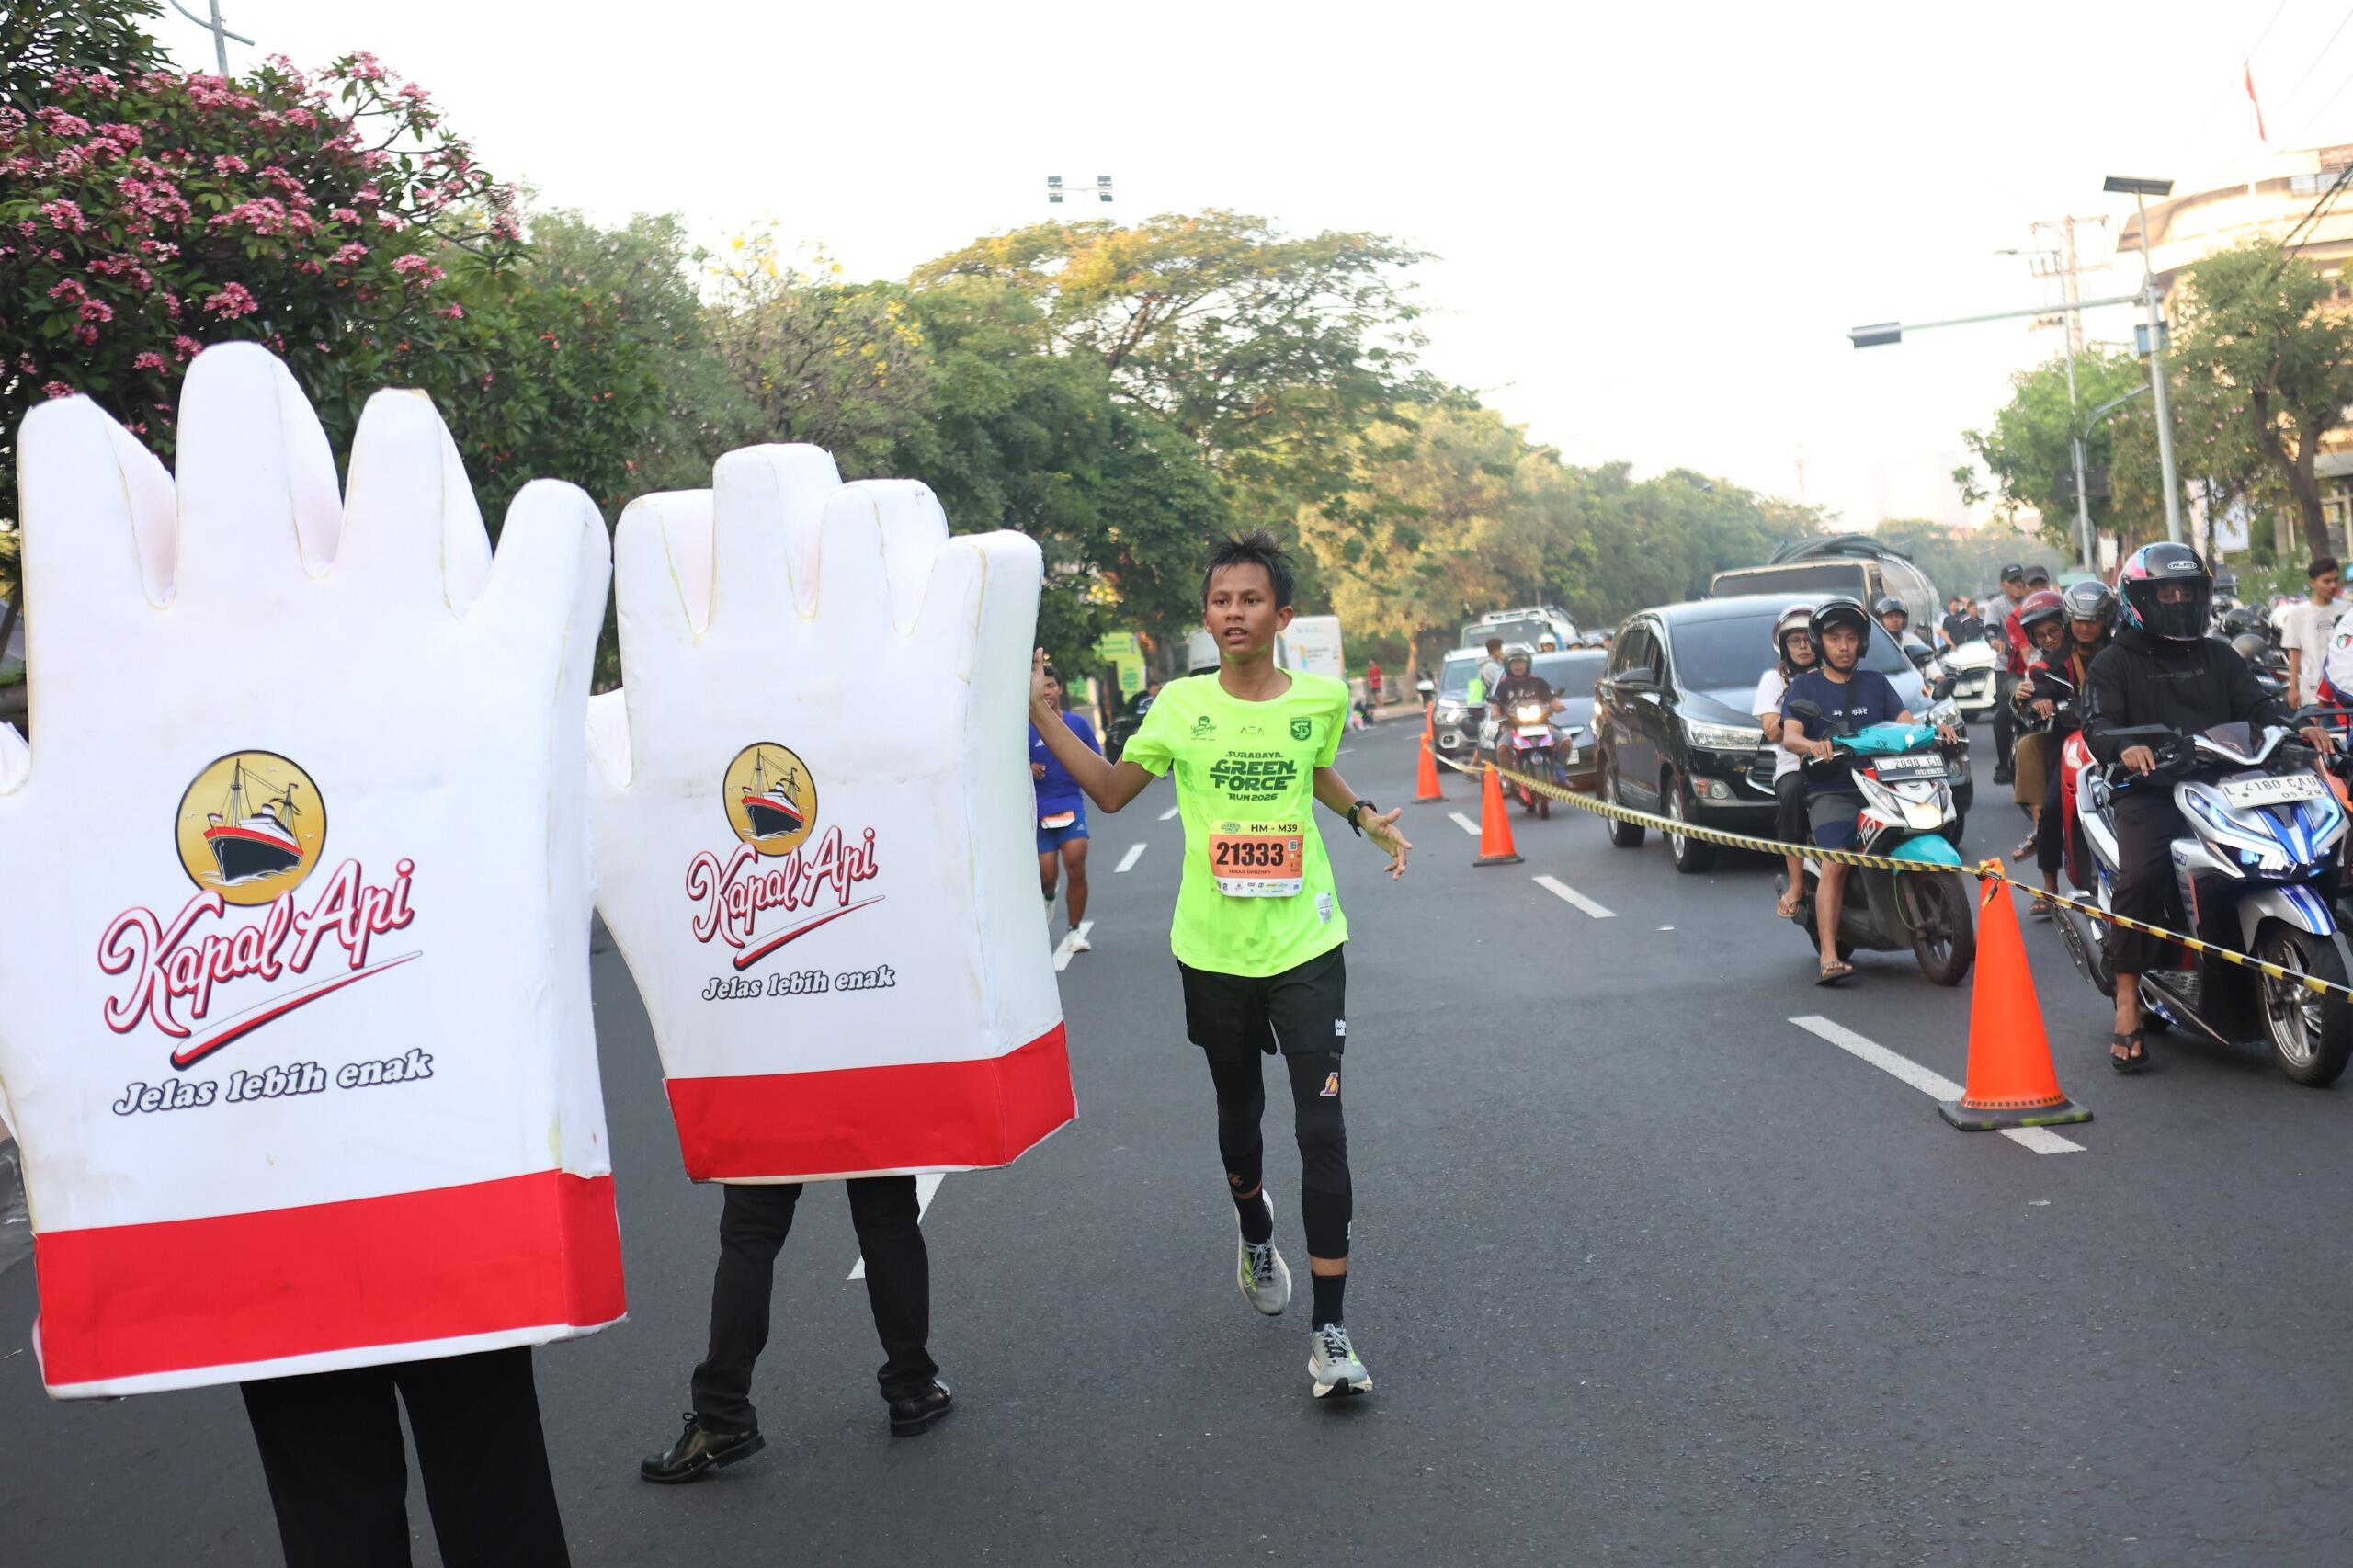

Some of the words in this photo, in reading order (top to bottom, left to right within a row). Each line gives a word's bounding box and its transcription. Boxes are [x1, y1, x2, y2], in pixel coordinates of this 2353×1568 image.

[1210, 759, 1298, 775] GREEN
[1225, 750, 1284, 759] SURABAYA
[1210, 773, 1296, 791] FORCE
[1227, 792, 1251, 801] RUN
[1251, 793, 1279, 801] 2026
[1216, 841, 1284, 866] 21333
[686, 842, 801, 948] Kapal
[802, 824, 878, 906] Api
[97, 890, 292, 1037] Kapal
[290, 858, 415, 971] Api
[701, 976, 762, 1001] Jelas
[767, 971, 828, 997] lebih
[835, 964, 896, 991] enak
[112, 1077, 217, 1116] Jelas
[225, 1061, 325, 1103] lebih
[336, 1048, 434, 1087] enak
